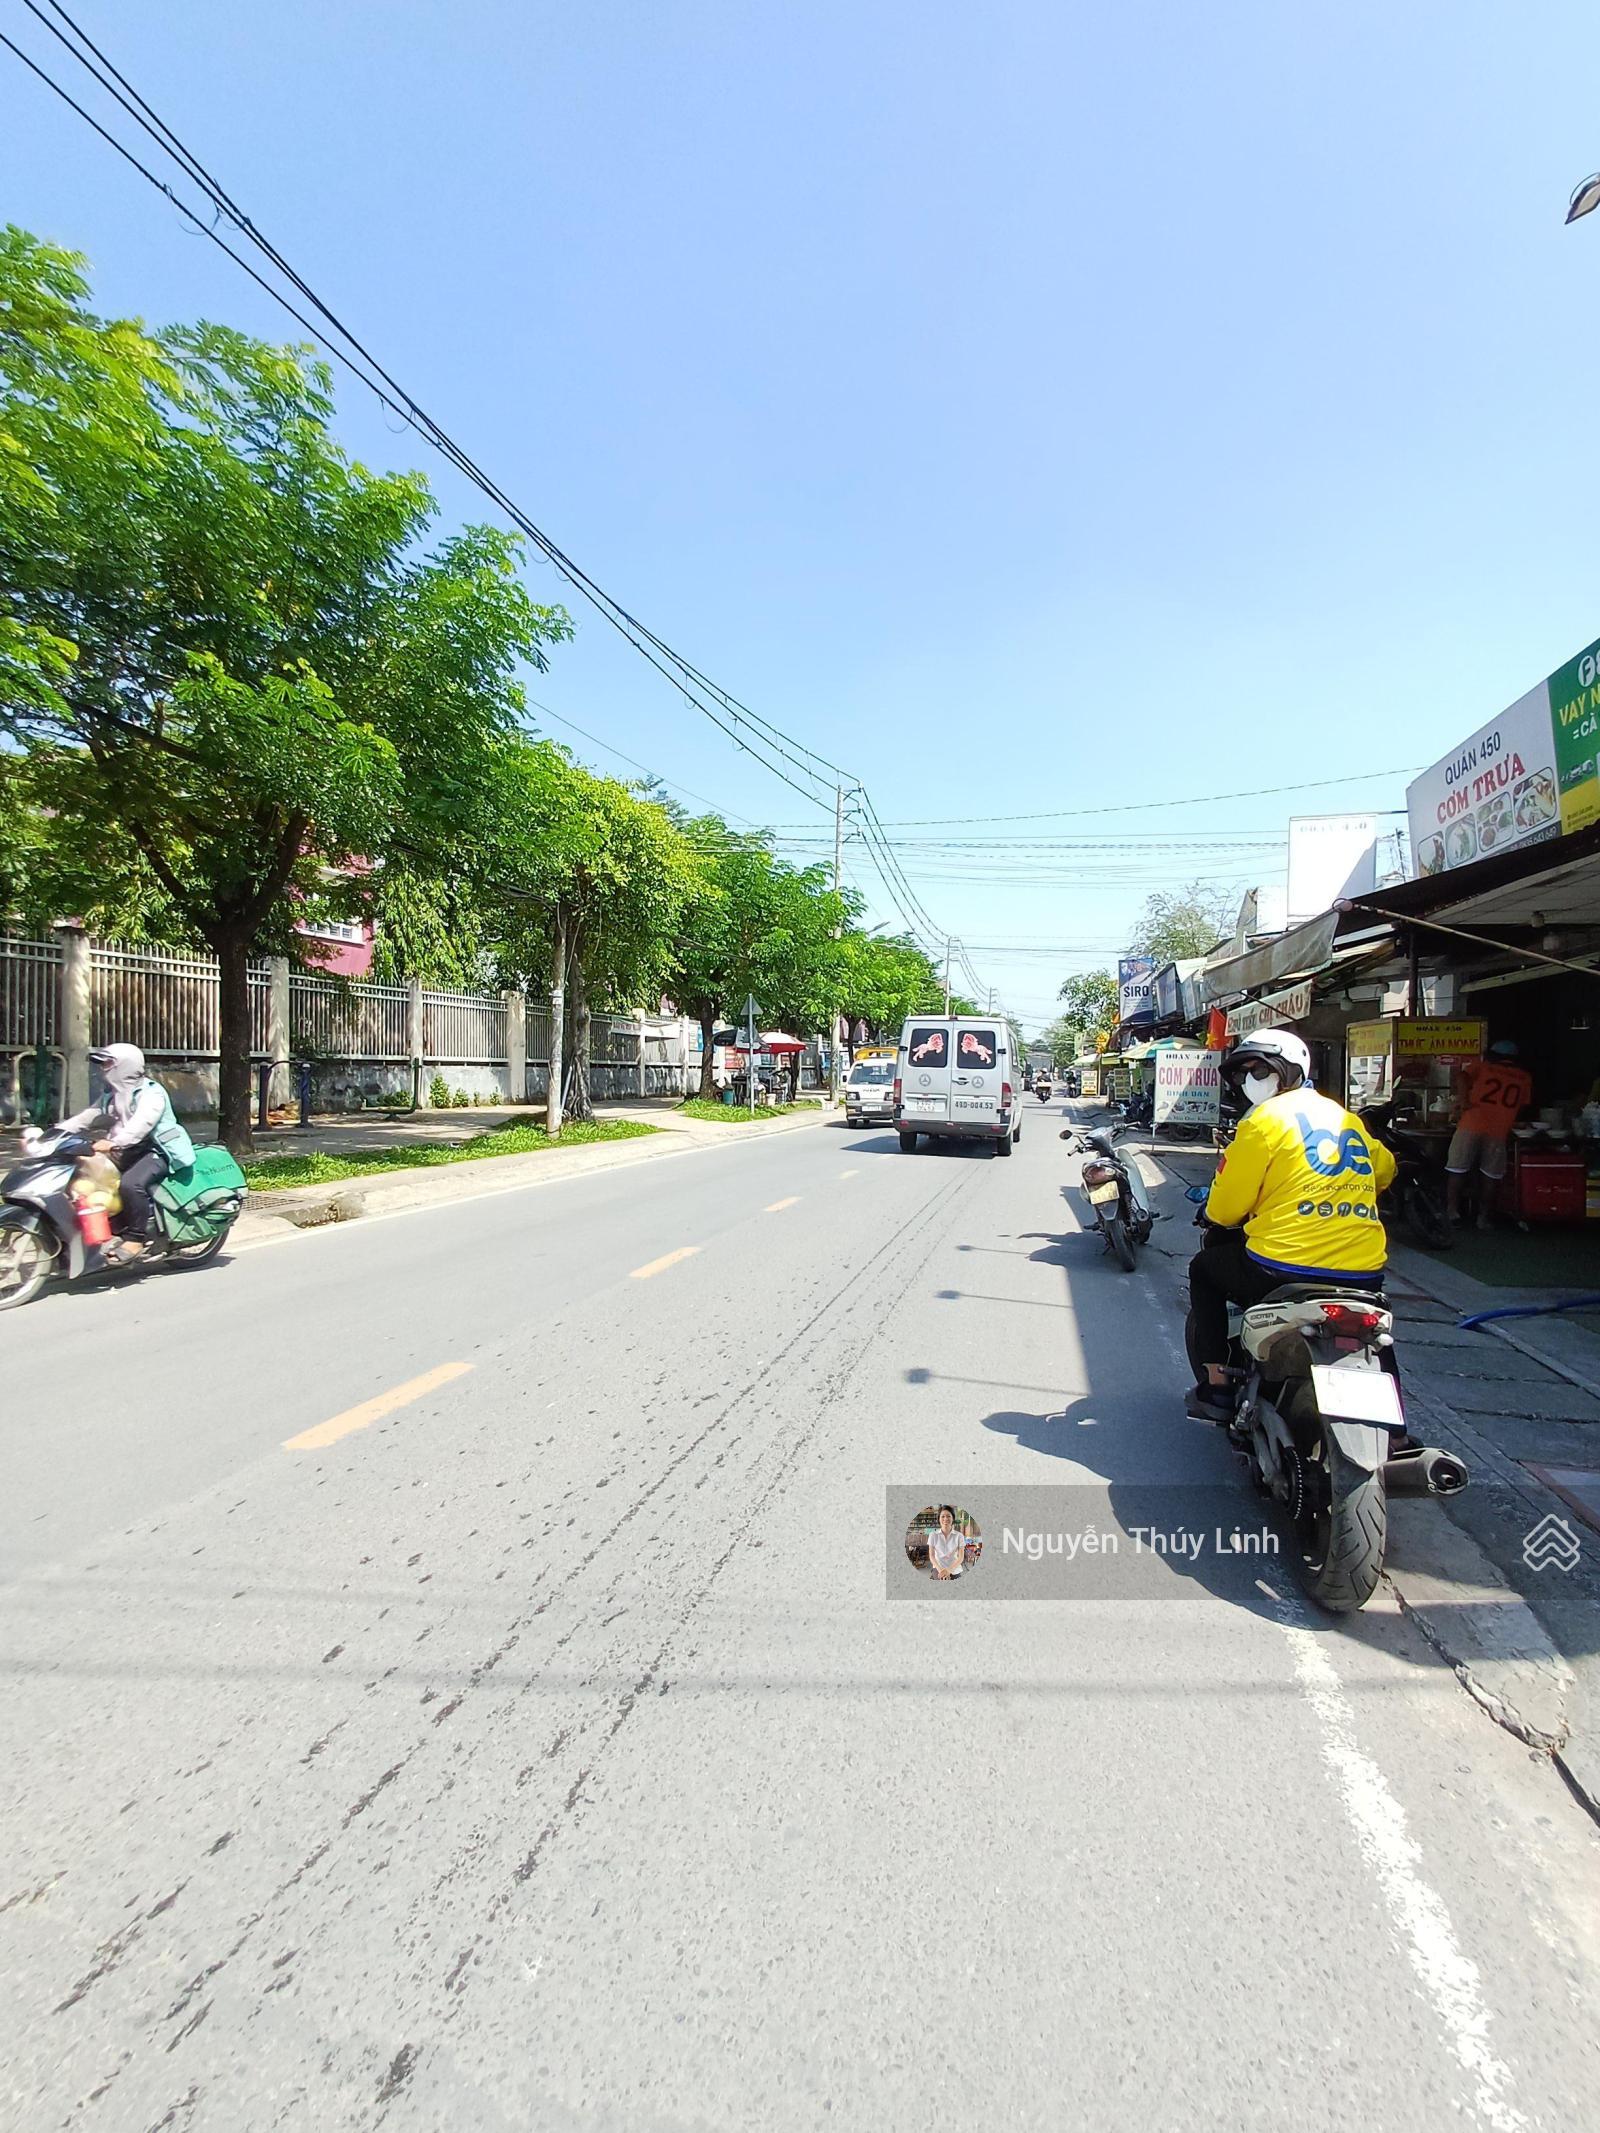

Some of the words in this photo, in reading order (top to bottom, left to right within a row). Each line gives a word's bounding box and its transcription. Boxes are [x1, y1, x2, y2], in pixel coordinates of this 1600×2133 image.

[1559, 692, 1586, 727] VAY
[1445, 748, 1477, 785] QUÁN
[1480, 731, 1501, 760] 450
[1437, 786, 1470, 824] CƠM
[1472, 752, 1525, 802] TRƯA
[1123, 985, 1149, 998] SIRO
[1479, 1078, 1520, 1109] 20
